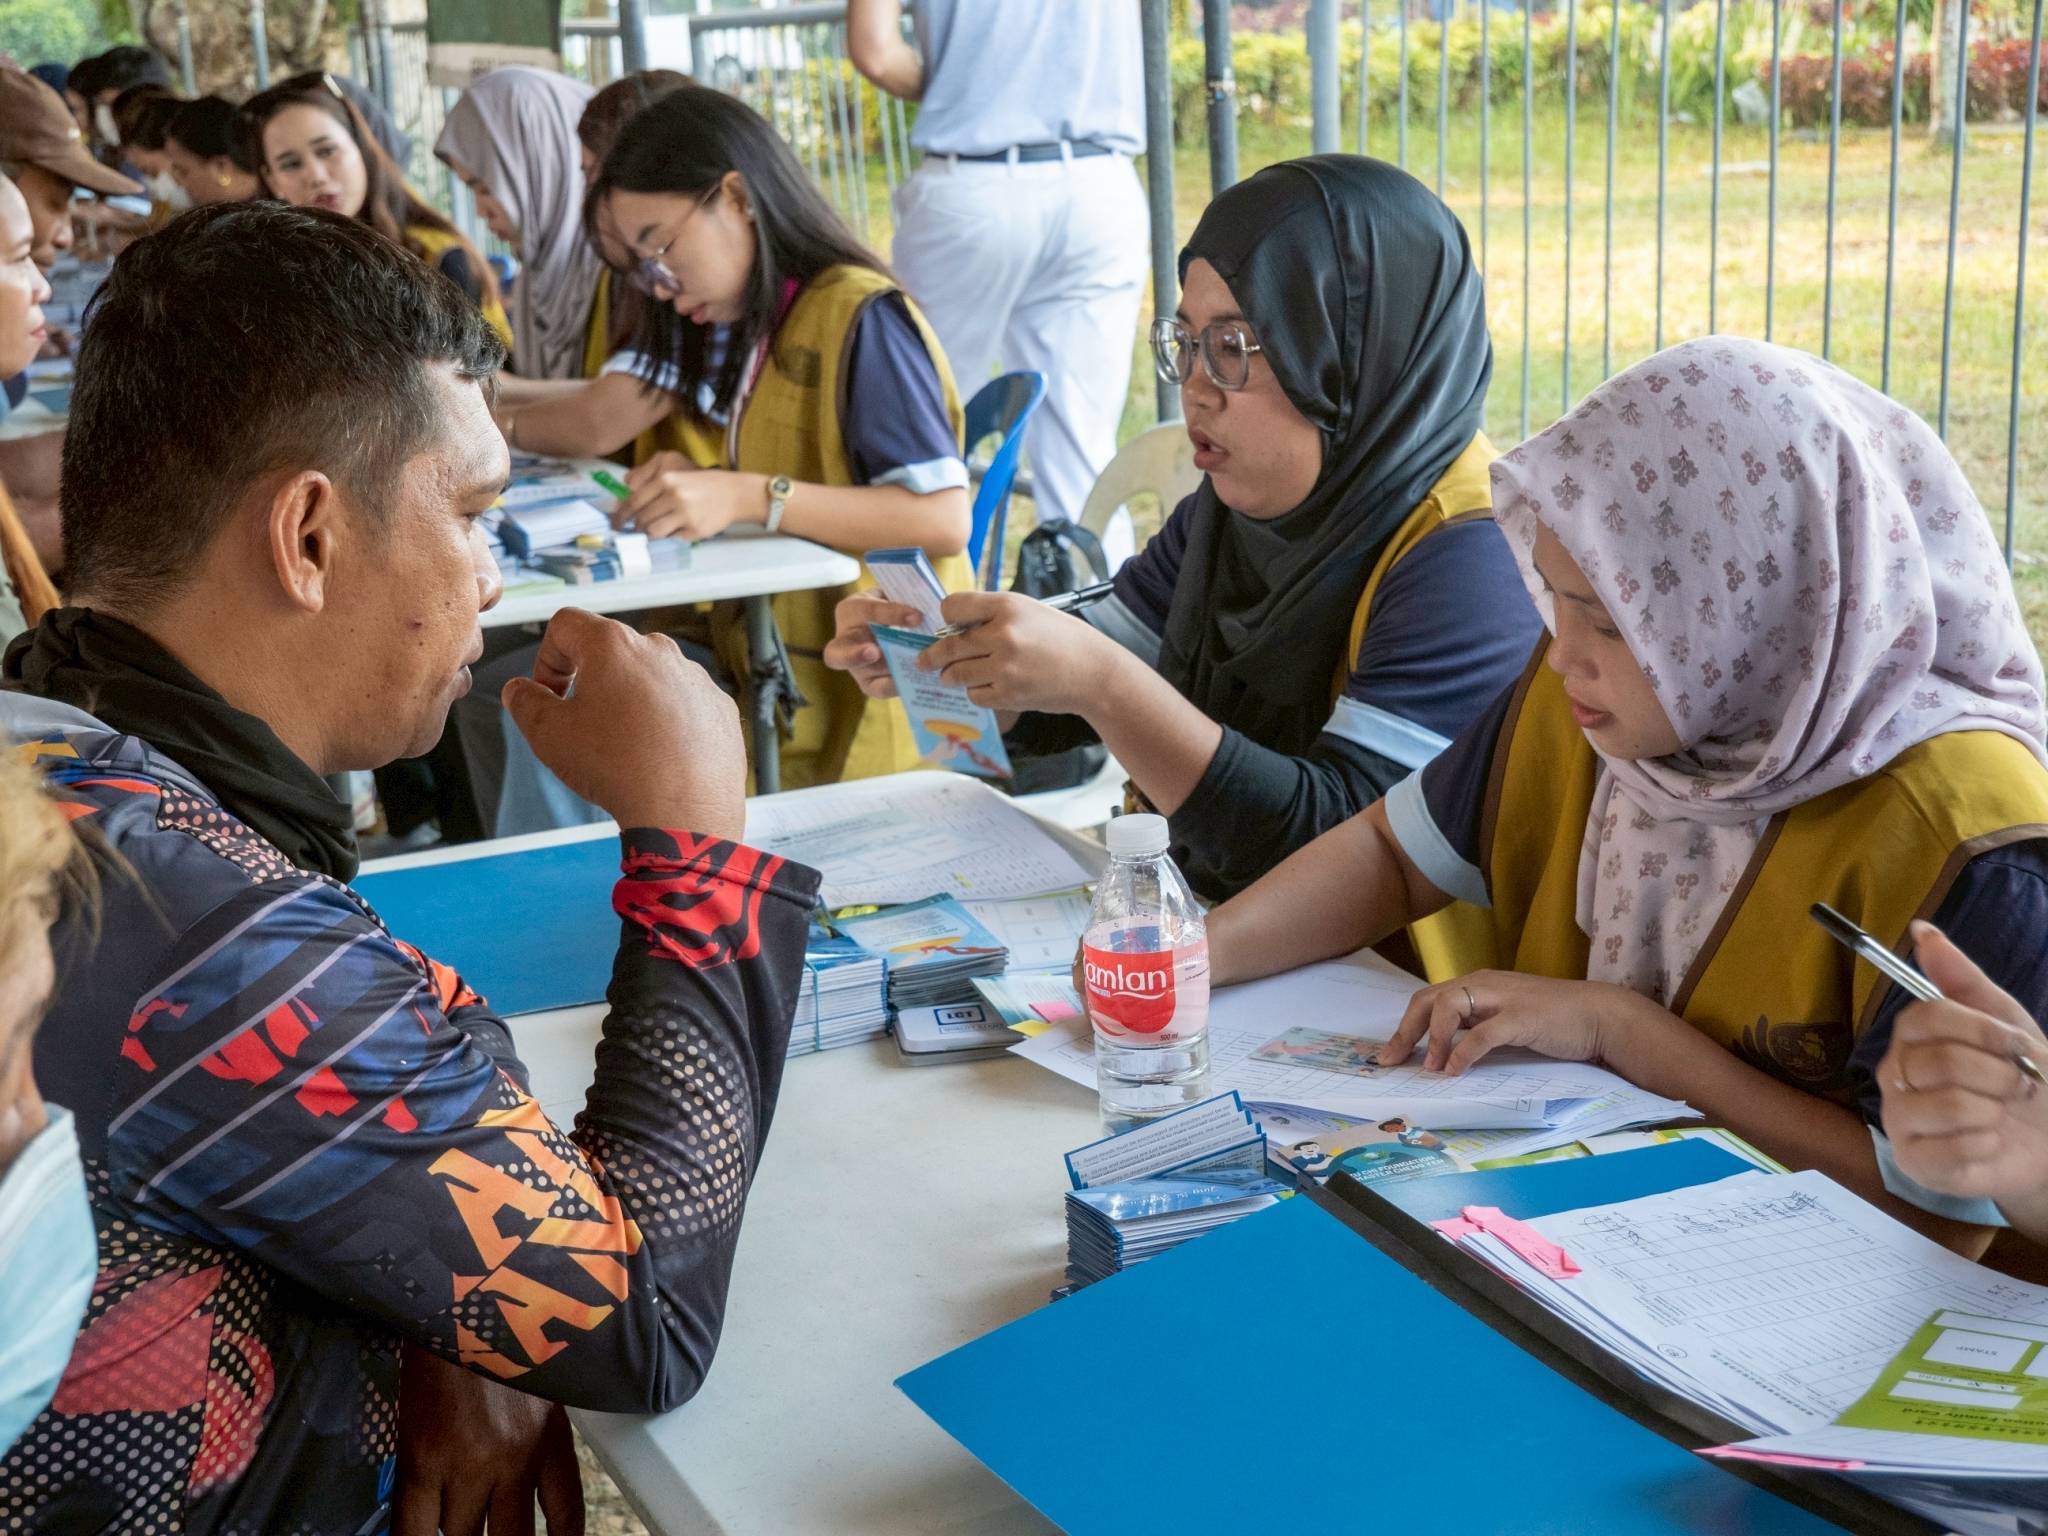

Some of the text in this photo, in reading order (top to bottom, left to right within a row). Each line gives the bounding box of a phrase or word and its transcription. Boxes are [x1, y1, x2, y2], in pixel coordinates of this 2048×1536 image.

[1378, 1155, 1436, 1171] FOUNDATION
[1956, 1345, 1999, 1355] STAMP
[1902, 1407, 1941, 1416] Card
